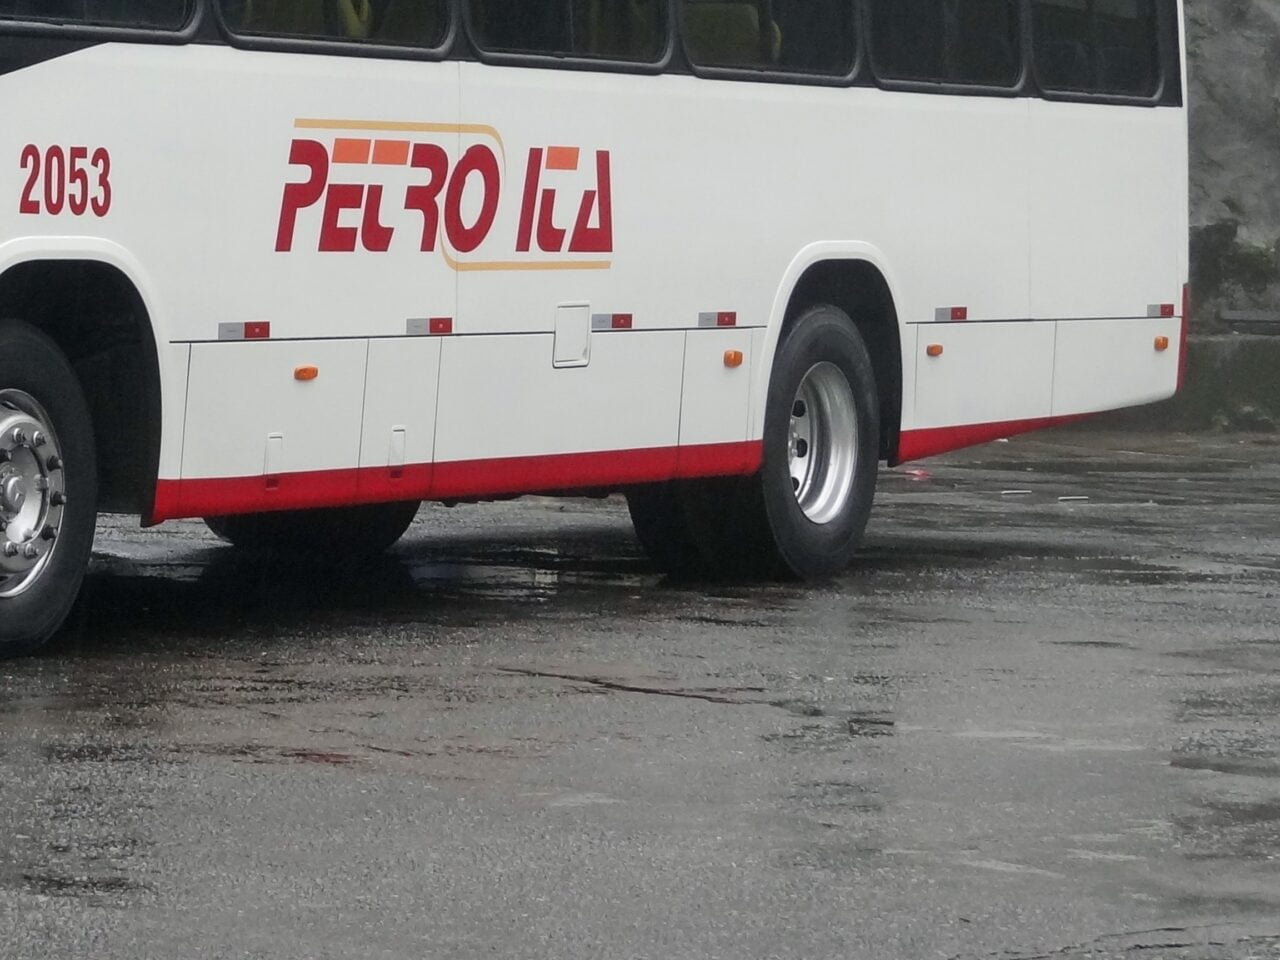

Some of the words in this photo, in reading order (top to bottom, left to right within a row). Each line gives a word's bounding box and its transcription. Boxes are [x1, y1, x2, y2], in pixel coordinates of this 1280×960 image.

[19, 143, 113, 218] 2053
[274, 138, 501, 253] PETRO
[515, 146, 614, 253] ITA
